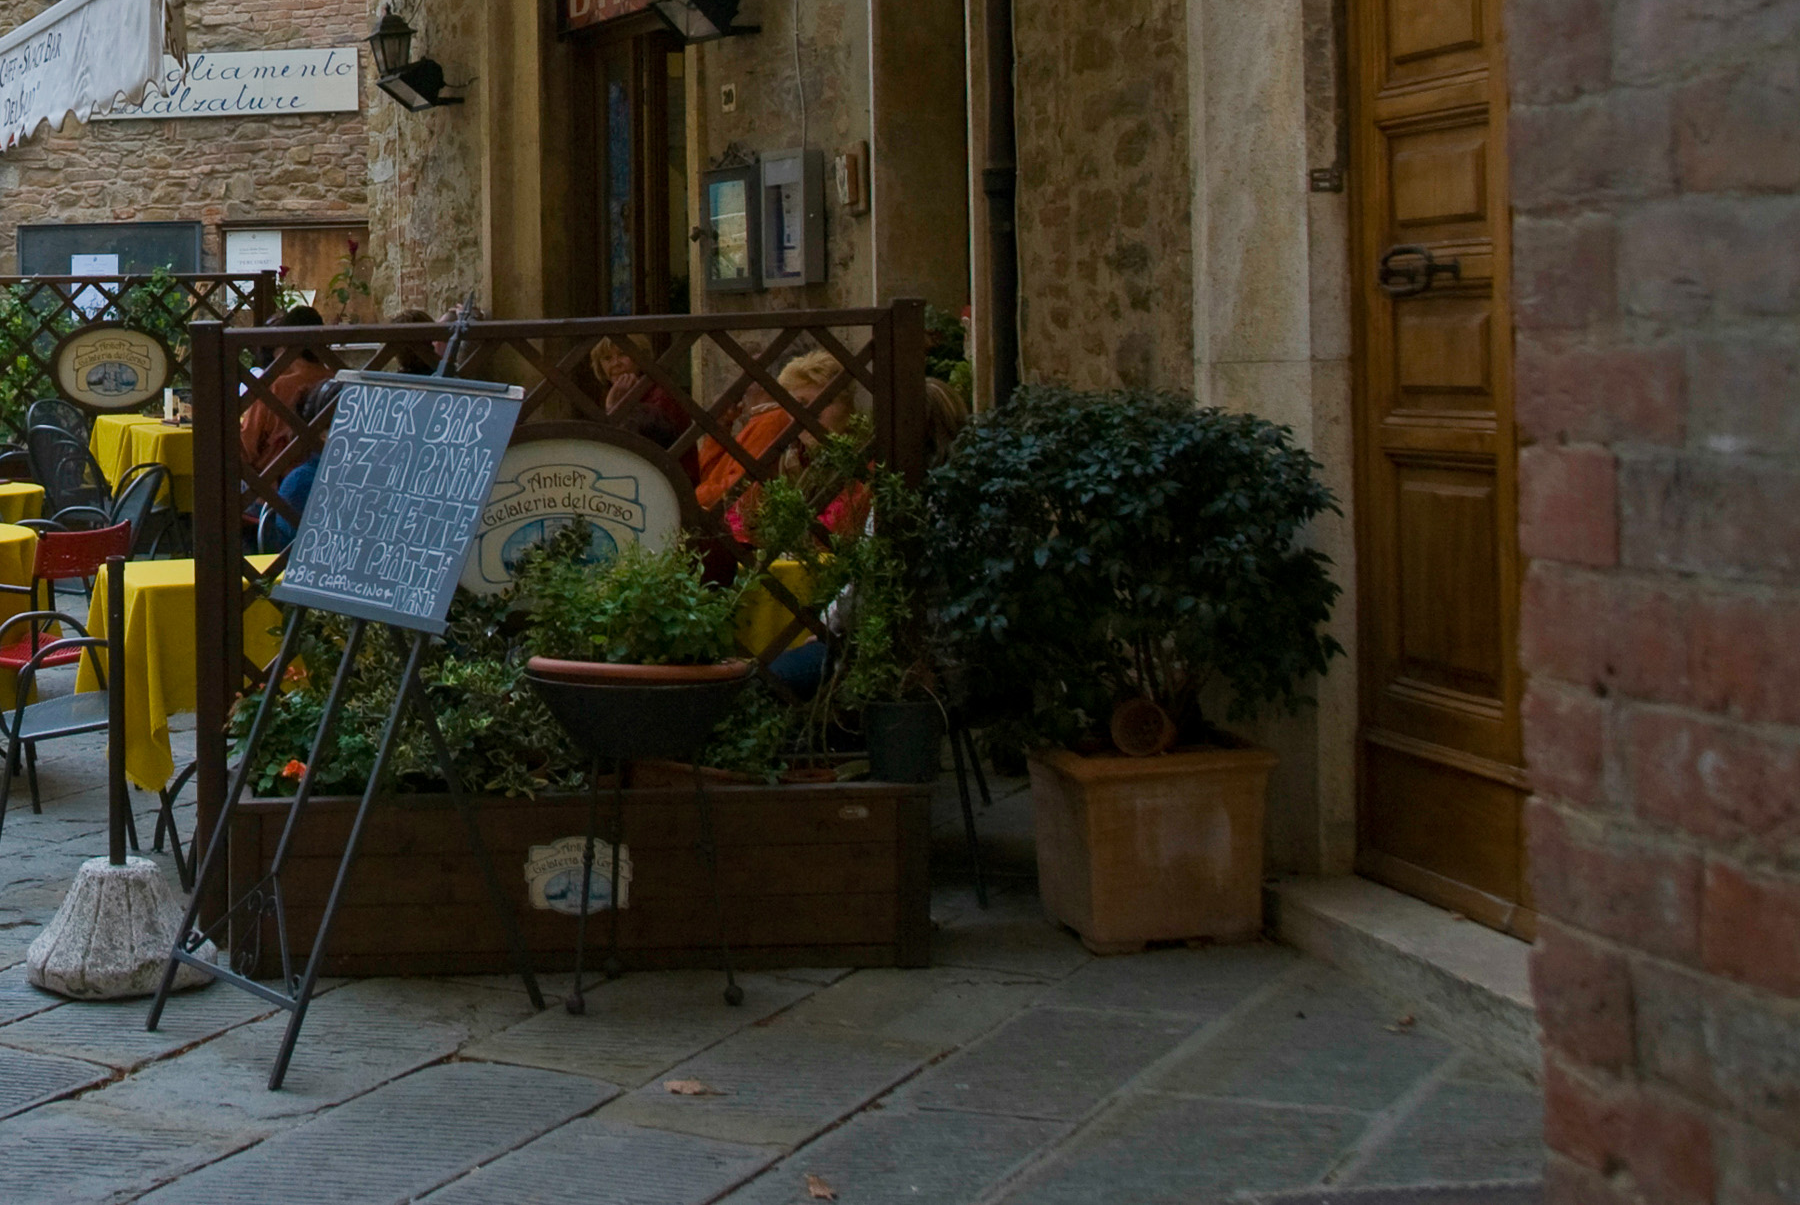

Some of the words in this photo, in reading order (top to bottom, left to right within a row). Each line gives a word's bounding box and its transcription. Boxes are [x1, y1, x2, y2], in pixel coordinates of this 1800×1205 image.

[43, 32, 62, 63] BAR
[166, 50, 356, 96] gliamento
[328, 384, 427, 440] SNACK
[422, 393, 493, 447] BAR
[306, 484, 480, 556] BRUSCHETTE
[482, 493, 557, 527] Gelateria
[561, 492, 587, 510] del
[588, 495, 634, 522] Corso
